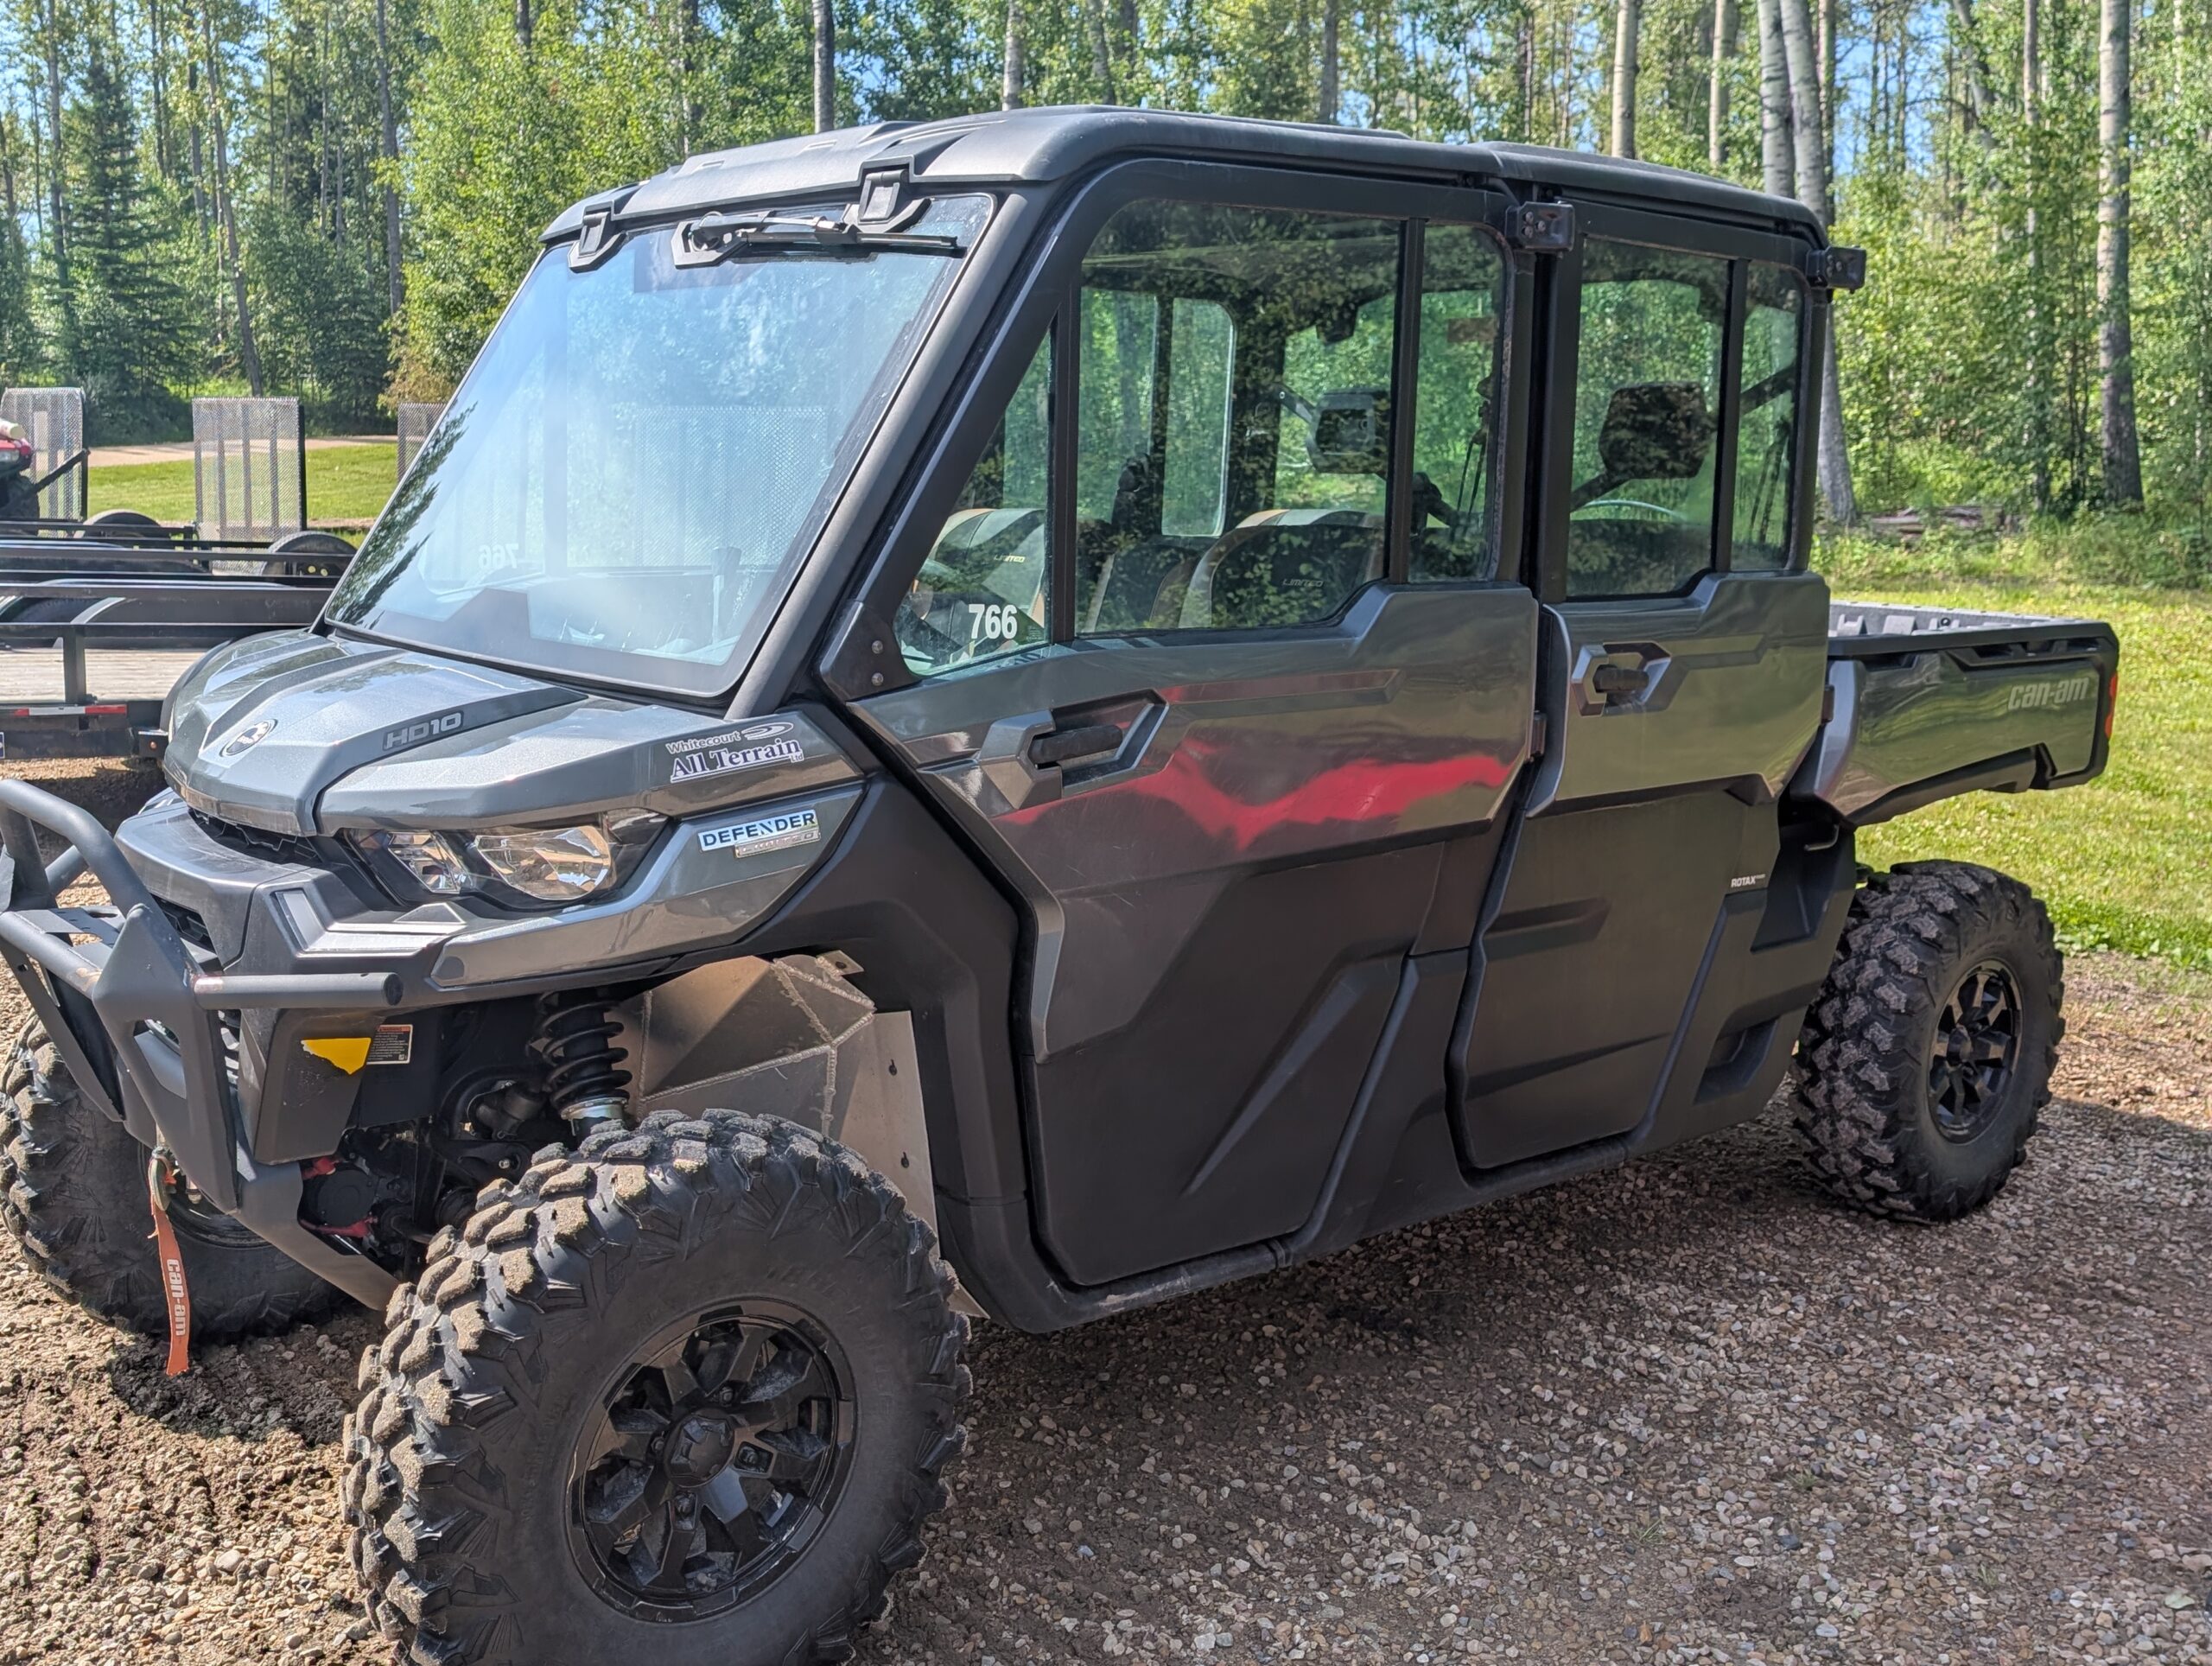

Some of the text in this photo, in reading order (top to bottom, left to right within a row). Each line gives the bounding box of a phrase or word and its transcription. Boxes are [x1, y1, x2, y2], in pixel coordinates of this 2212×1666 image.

[1282, 577, 1324, 588] LIMITED
[968, 603, 1018, 639] 766
[2007, 677, 2089, 709] can-am
[385, 711, 462, 750] HD10
[665, 731, 741, 754] Whitecourt
[670, 738, 802, 780] All Terrain
[790, 753, 804, 763] Ltd
[702, 811, 816, 848] DEFENDER
[1731, 875, 1757, 888] ROTAX
[167, 1258, 186, 1337] can-am
